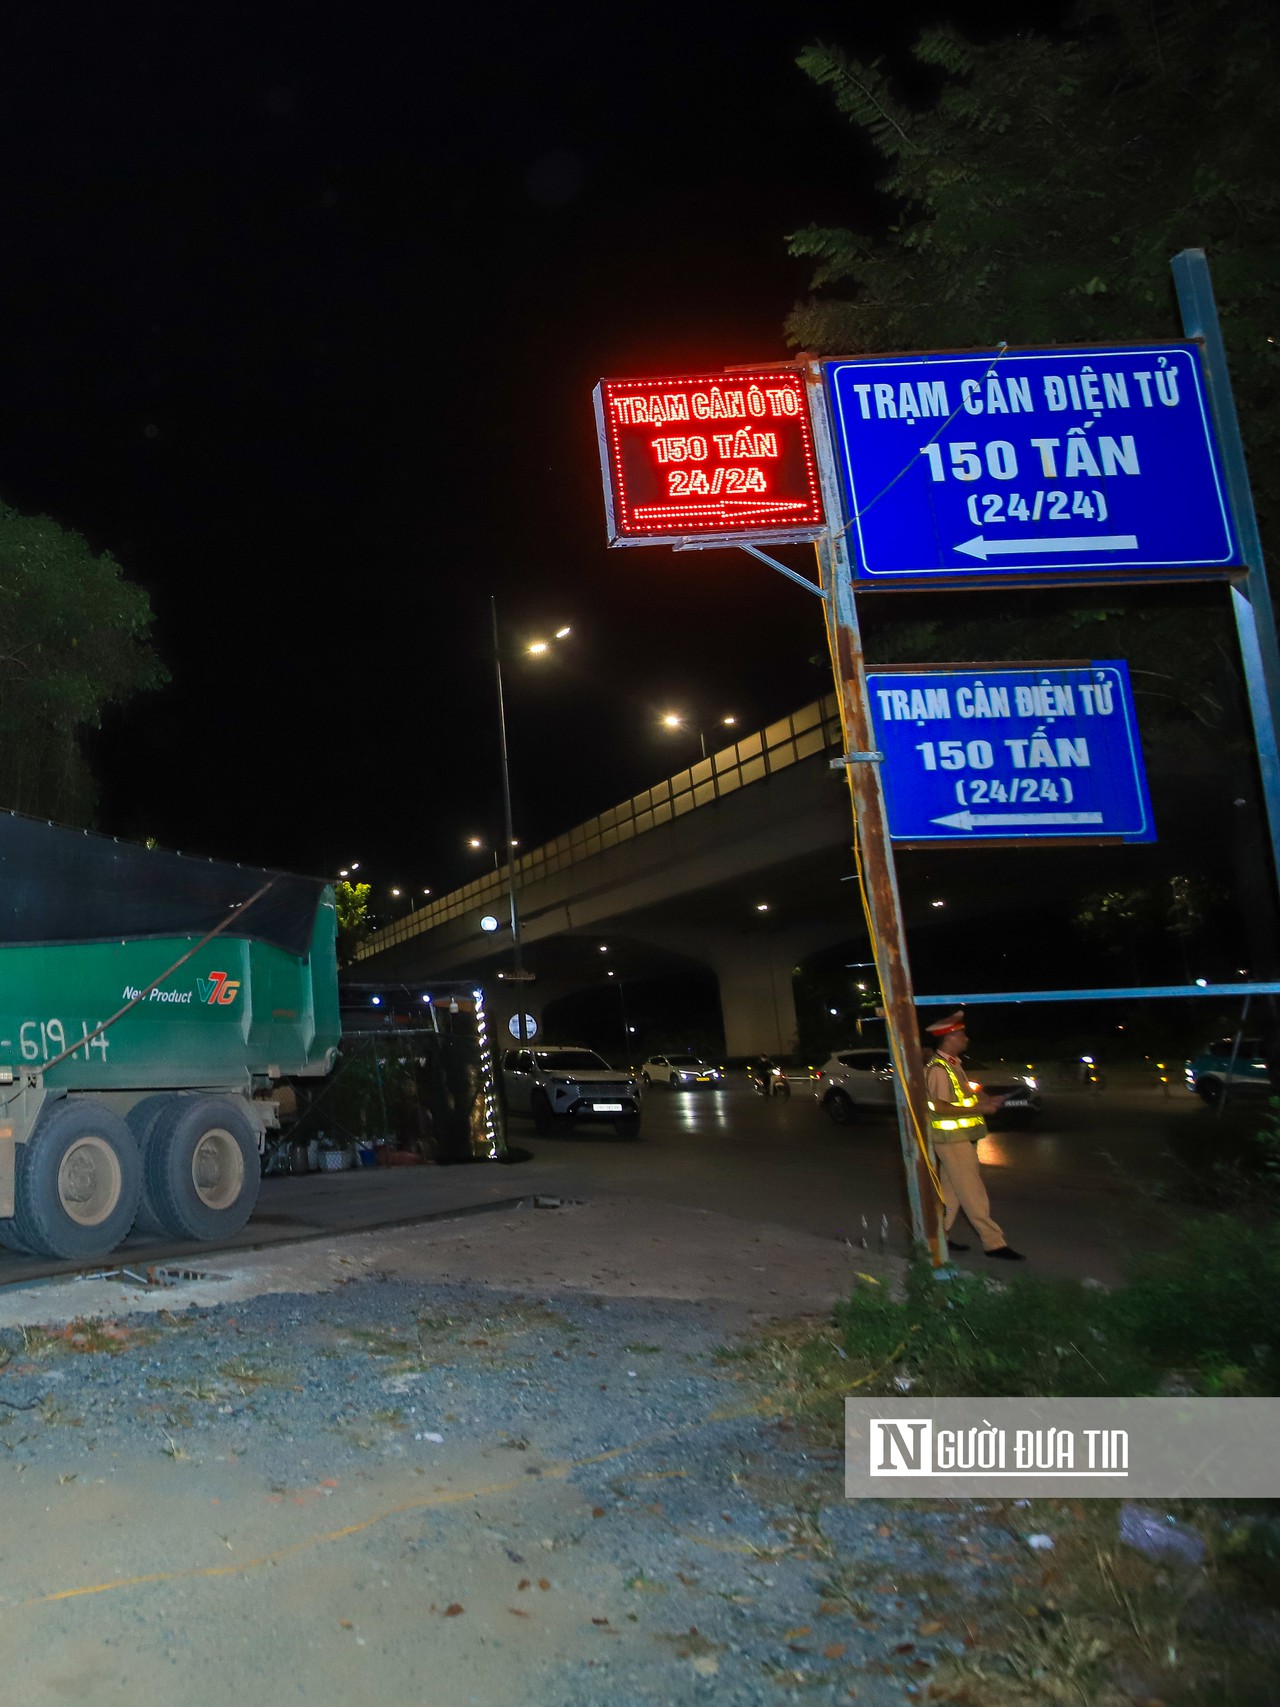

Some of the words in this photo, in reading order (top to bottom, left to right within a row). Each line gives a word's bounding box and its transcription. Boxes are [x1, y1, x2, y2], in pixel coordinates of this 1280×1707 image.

[613, 394, 690, 427] TRẠM
[691, 386, 746, 420] CÂN
[746, 384, 766, 418] Ô
[853, 380, 950, 425] TRẠM
[960, 369, 1034, 415] CÂN
[1043, 366, 1130, 418] ĐIỆN
[1133, 356, 1180, 408] TỬ
[651, 435, 708, 463] 150
[712, 425, 778, 458] TẤN
[919, 439, 1019, 483] 150
[1030, 420, 1141, 479] TẤN
[668, 467, 767, 496] 24/24
[966, 489, 1109, 526] (24/24)
[876, 688, 951, 727] TRẠM
[956, 680, 1011, 719] CÂN
[1014, 678, 1076, 723] ĐIỆN
[1078, 671, 1114, 716] TỬ
[915, 739, 994, 771] 150
[1004, 725, 1091, 769] TẤN
[954, 777, 1074, 806] (24/24)
[149, 988, 193, 1003] Product
